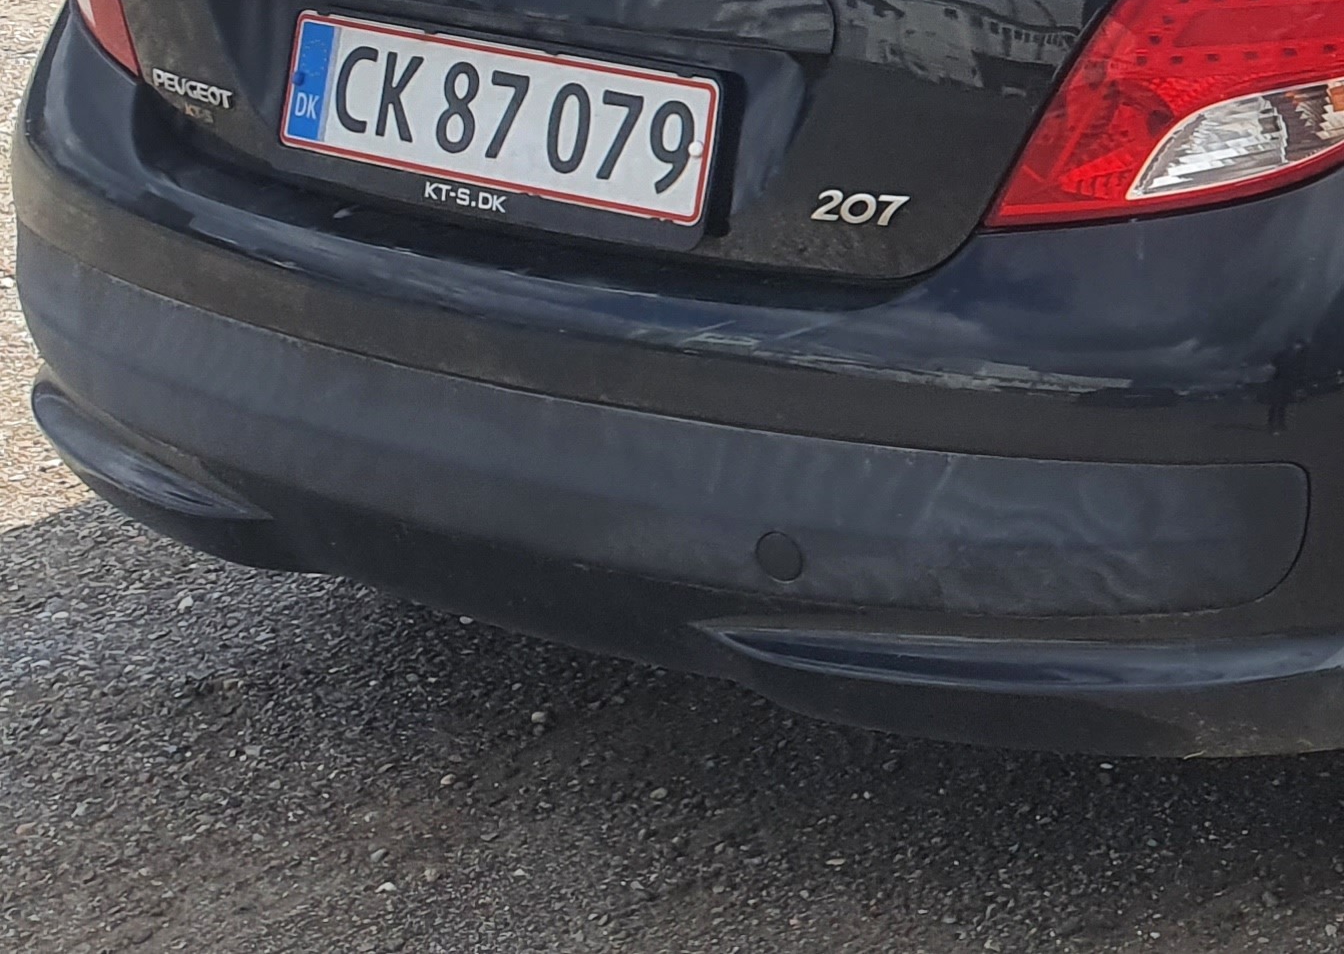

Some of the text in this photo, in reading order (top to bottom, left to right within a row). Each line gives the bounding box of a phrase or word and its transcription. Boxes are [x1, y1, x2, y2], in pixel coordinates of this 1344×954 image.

[152, 67, 233, 109] PEUGEOT
[294, 91, 319, 120] DK
[335, 46, 696, 195] CK 87 079
[423, 181, 506, 214] KT-S.DK
[810, 189, 911, 226] 207
